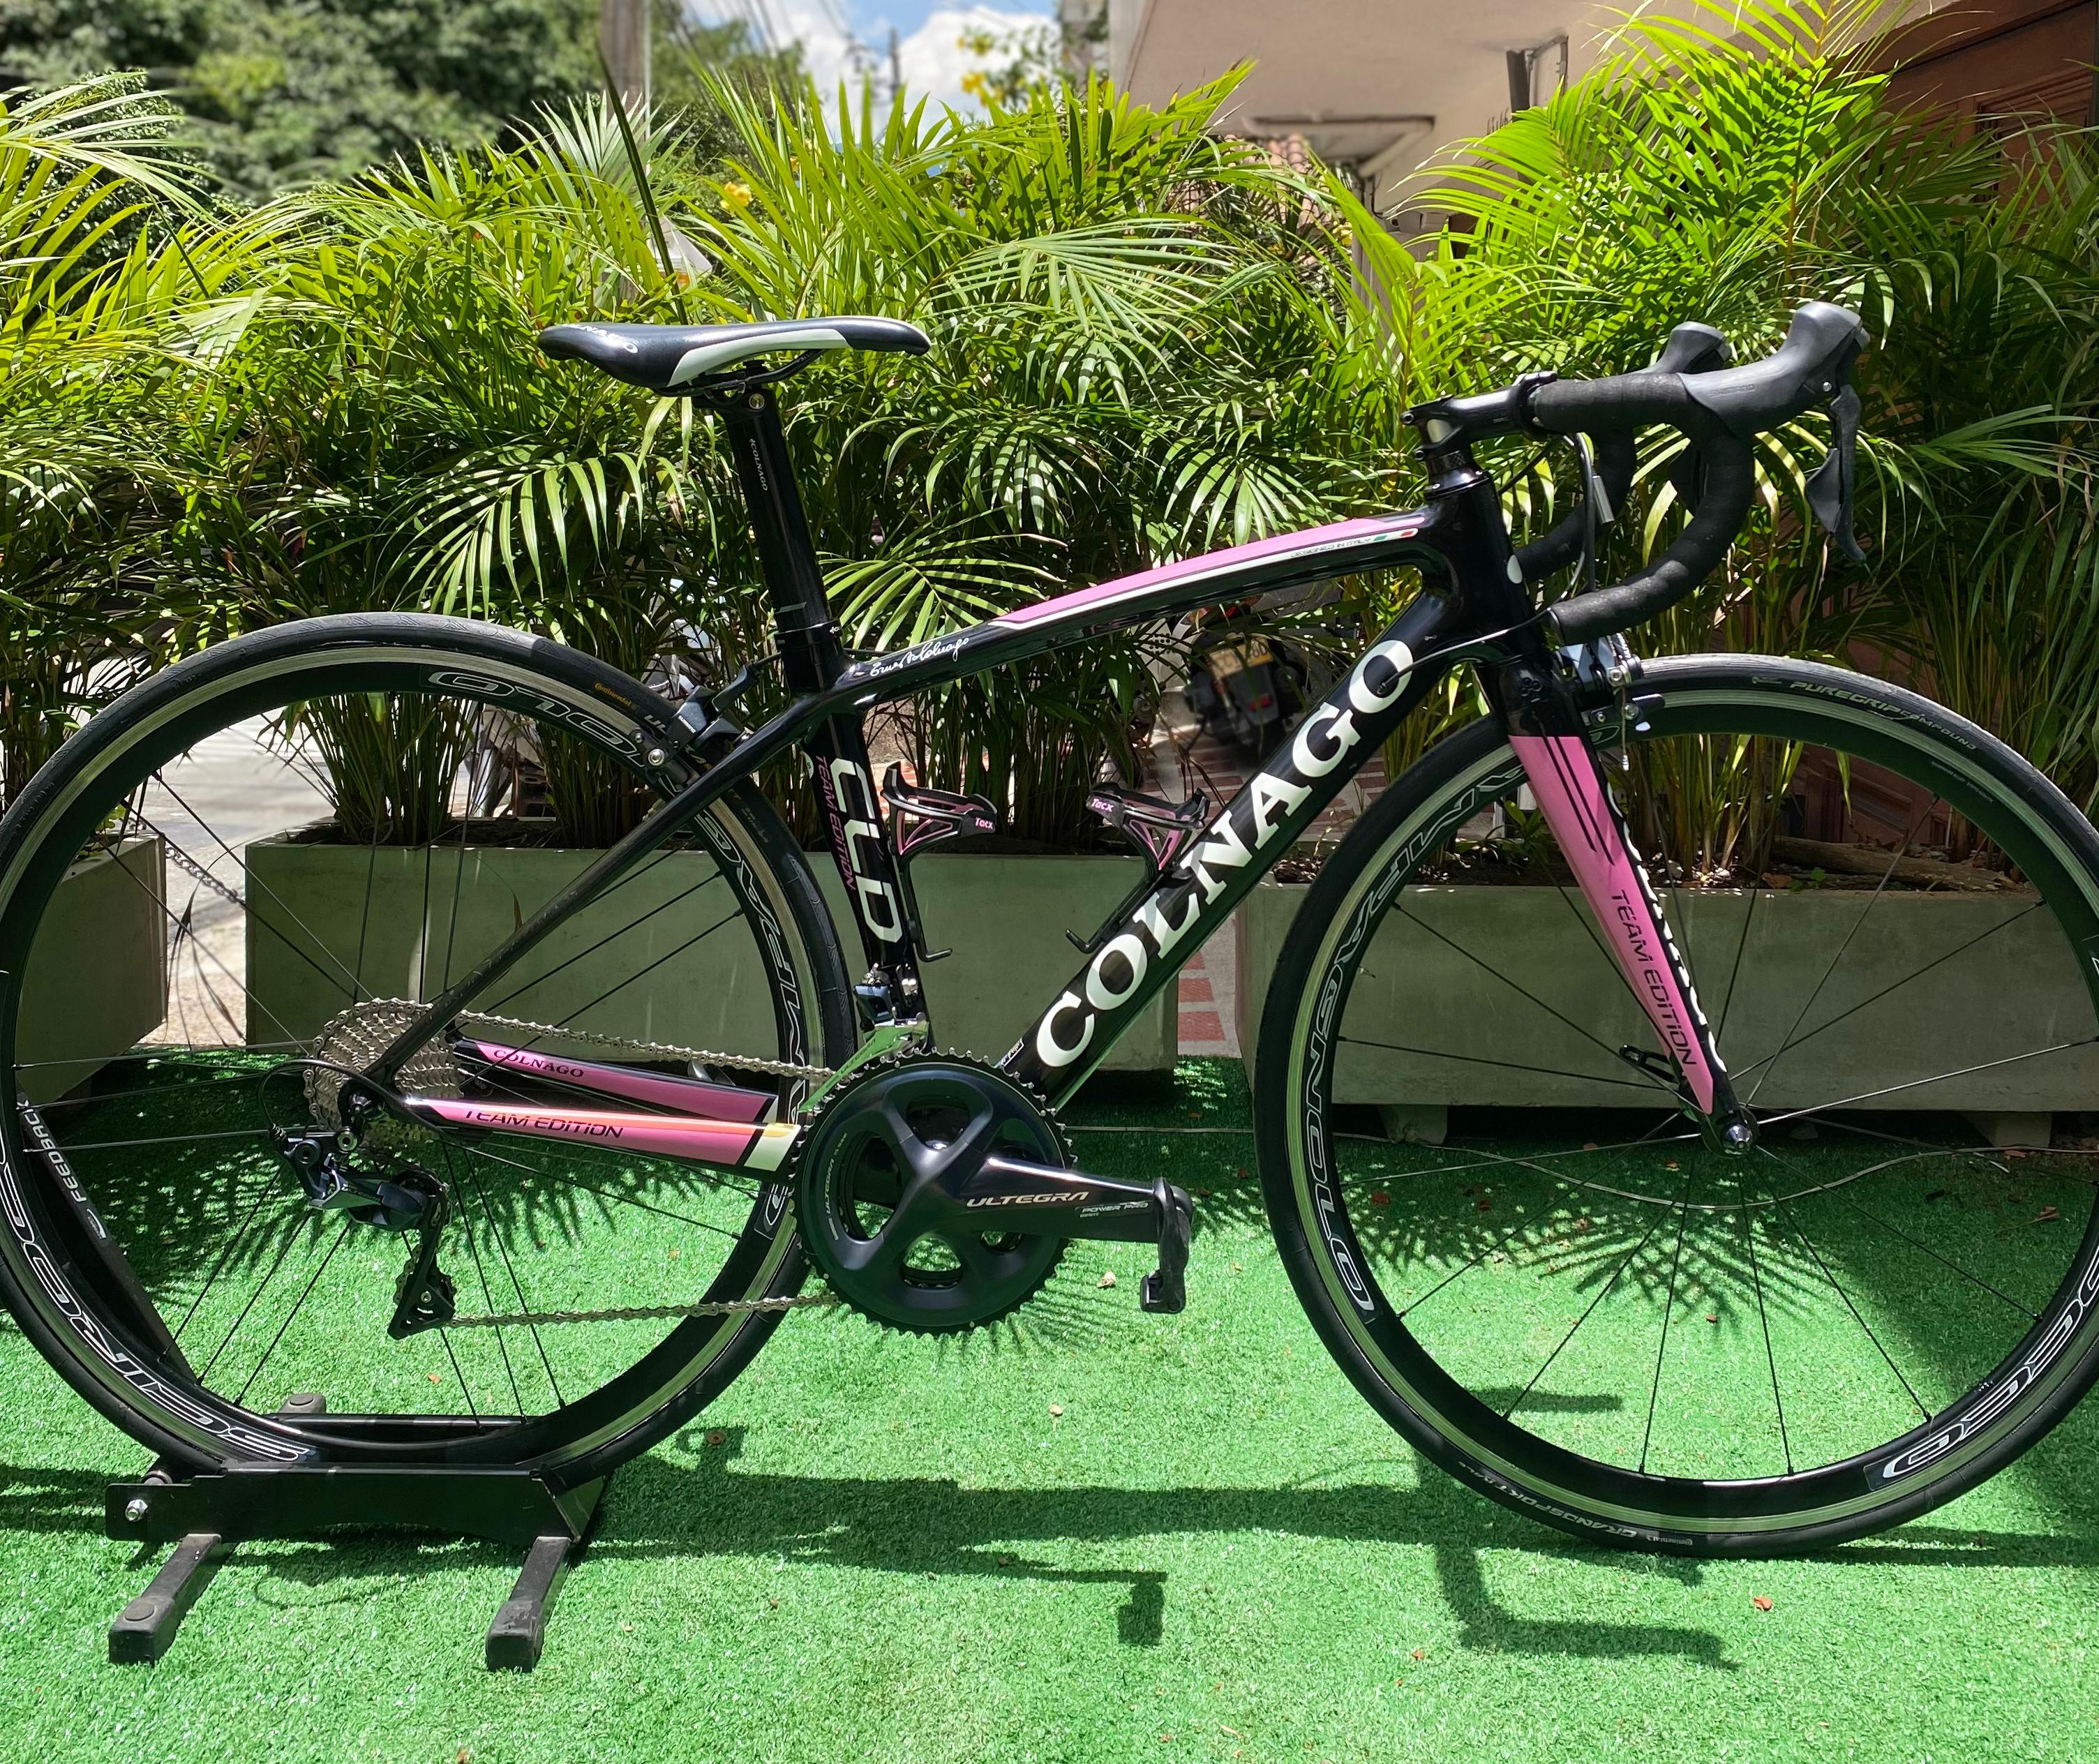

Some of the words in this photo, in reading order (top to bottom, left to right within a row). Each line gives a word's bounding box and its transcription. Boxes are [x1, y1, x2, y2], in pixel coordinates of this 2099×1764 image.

[750, 443, 768, 491] COLNAGO
[1291, 544, 1335, 558] DESIGNED
[1347, 537, 1371, 548] ITALY
[594, 682, 634, 707] Continental
[1790, 681, 1902, 714] PUREGRIP
[815, 756, 838, 815] TEAM
[1091, 798, 1114, 812] Tacx
[975, 817, 994, 830] Tacx
[1037, 640, 1414, 1068] COLNAGO
[1611, 889, 1654, 962] TEAM
[493, 1049, 584, 1078] COLNAGO
[466, 1110, 530, 1128] TEAM
[16, 1099, 87, 1203] FEEDBACK
[824, 1158, 835, 1215] ULTEGRA
[966, 1191, 1089, 1208] ULTEGRA
[1082, 1205, 1122, 1213] POWER
[1123, 1202, 1149, 1211] PRO
[0, 1115, 310, 1463] SCIROC
[1495, 1484, 1638, 1539] GRANDSPORT
